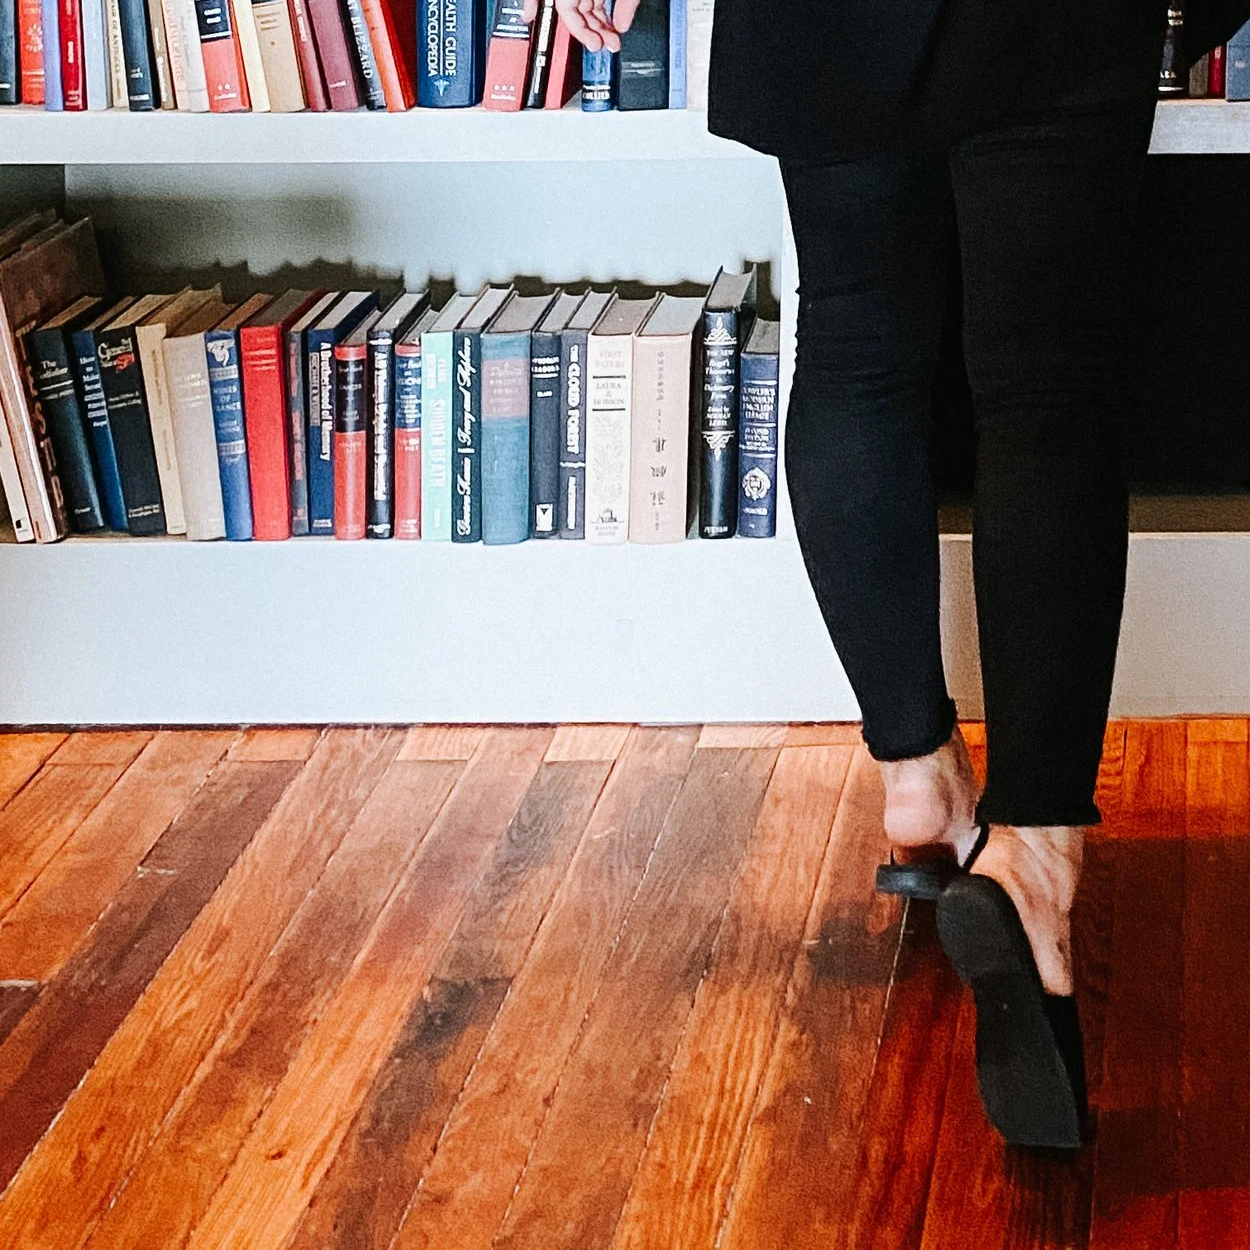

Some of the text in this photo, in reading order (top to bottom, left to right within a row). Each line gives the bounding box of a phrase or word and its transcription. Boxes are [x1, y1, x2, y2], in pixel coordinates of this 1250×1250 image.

[351, 16, 373, 79] BLIZZARD
[445, 36, 457, 76] GUIDE
[321, 342, 331, 350] A
[599, 351, 622, 359] FIRST
[321, 350, 332, 409] Brotherhood
[596, 382, 622, 390] LAURA
[593, 398, 625, 406] HOBSON
[323, 410, 331, 421] of
[429, 448, 446, 487] DEATH
